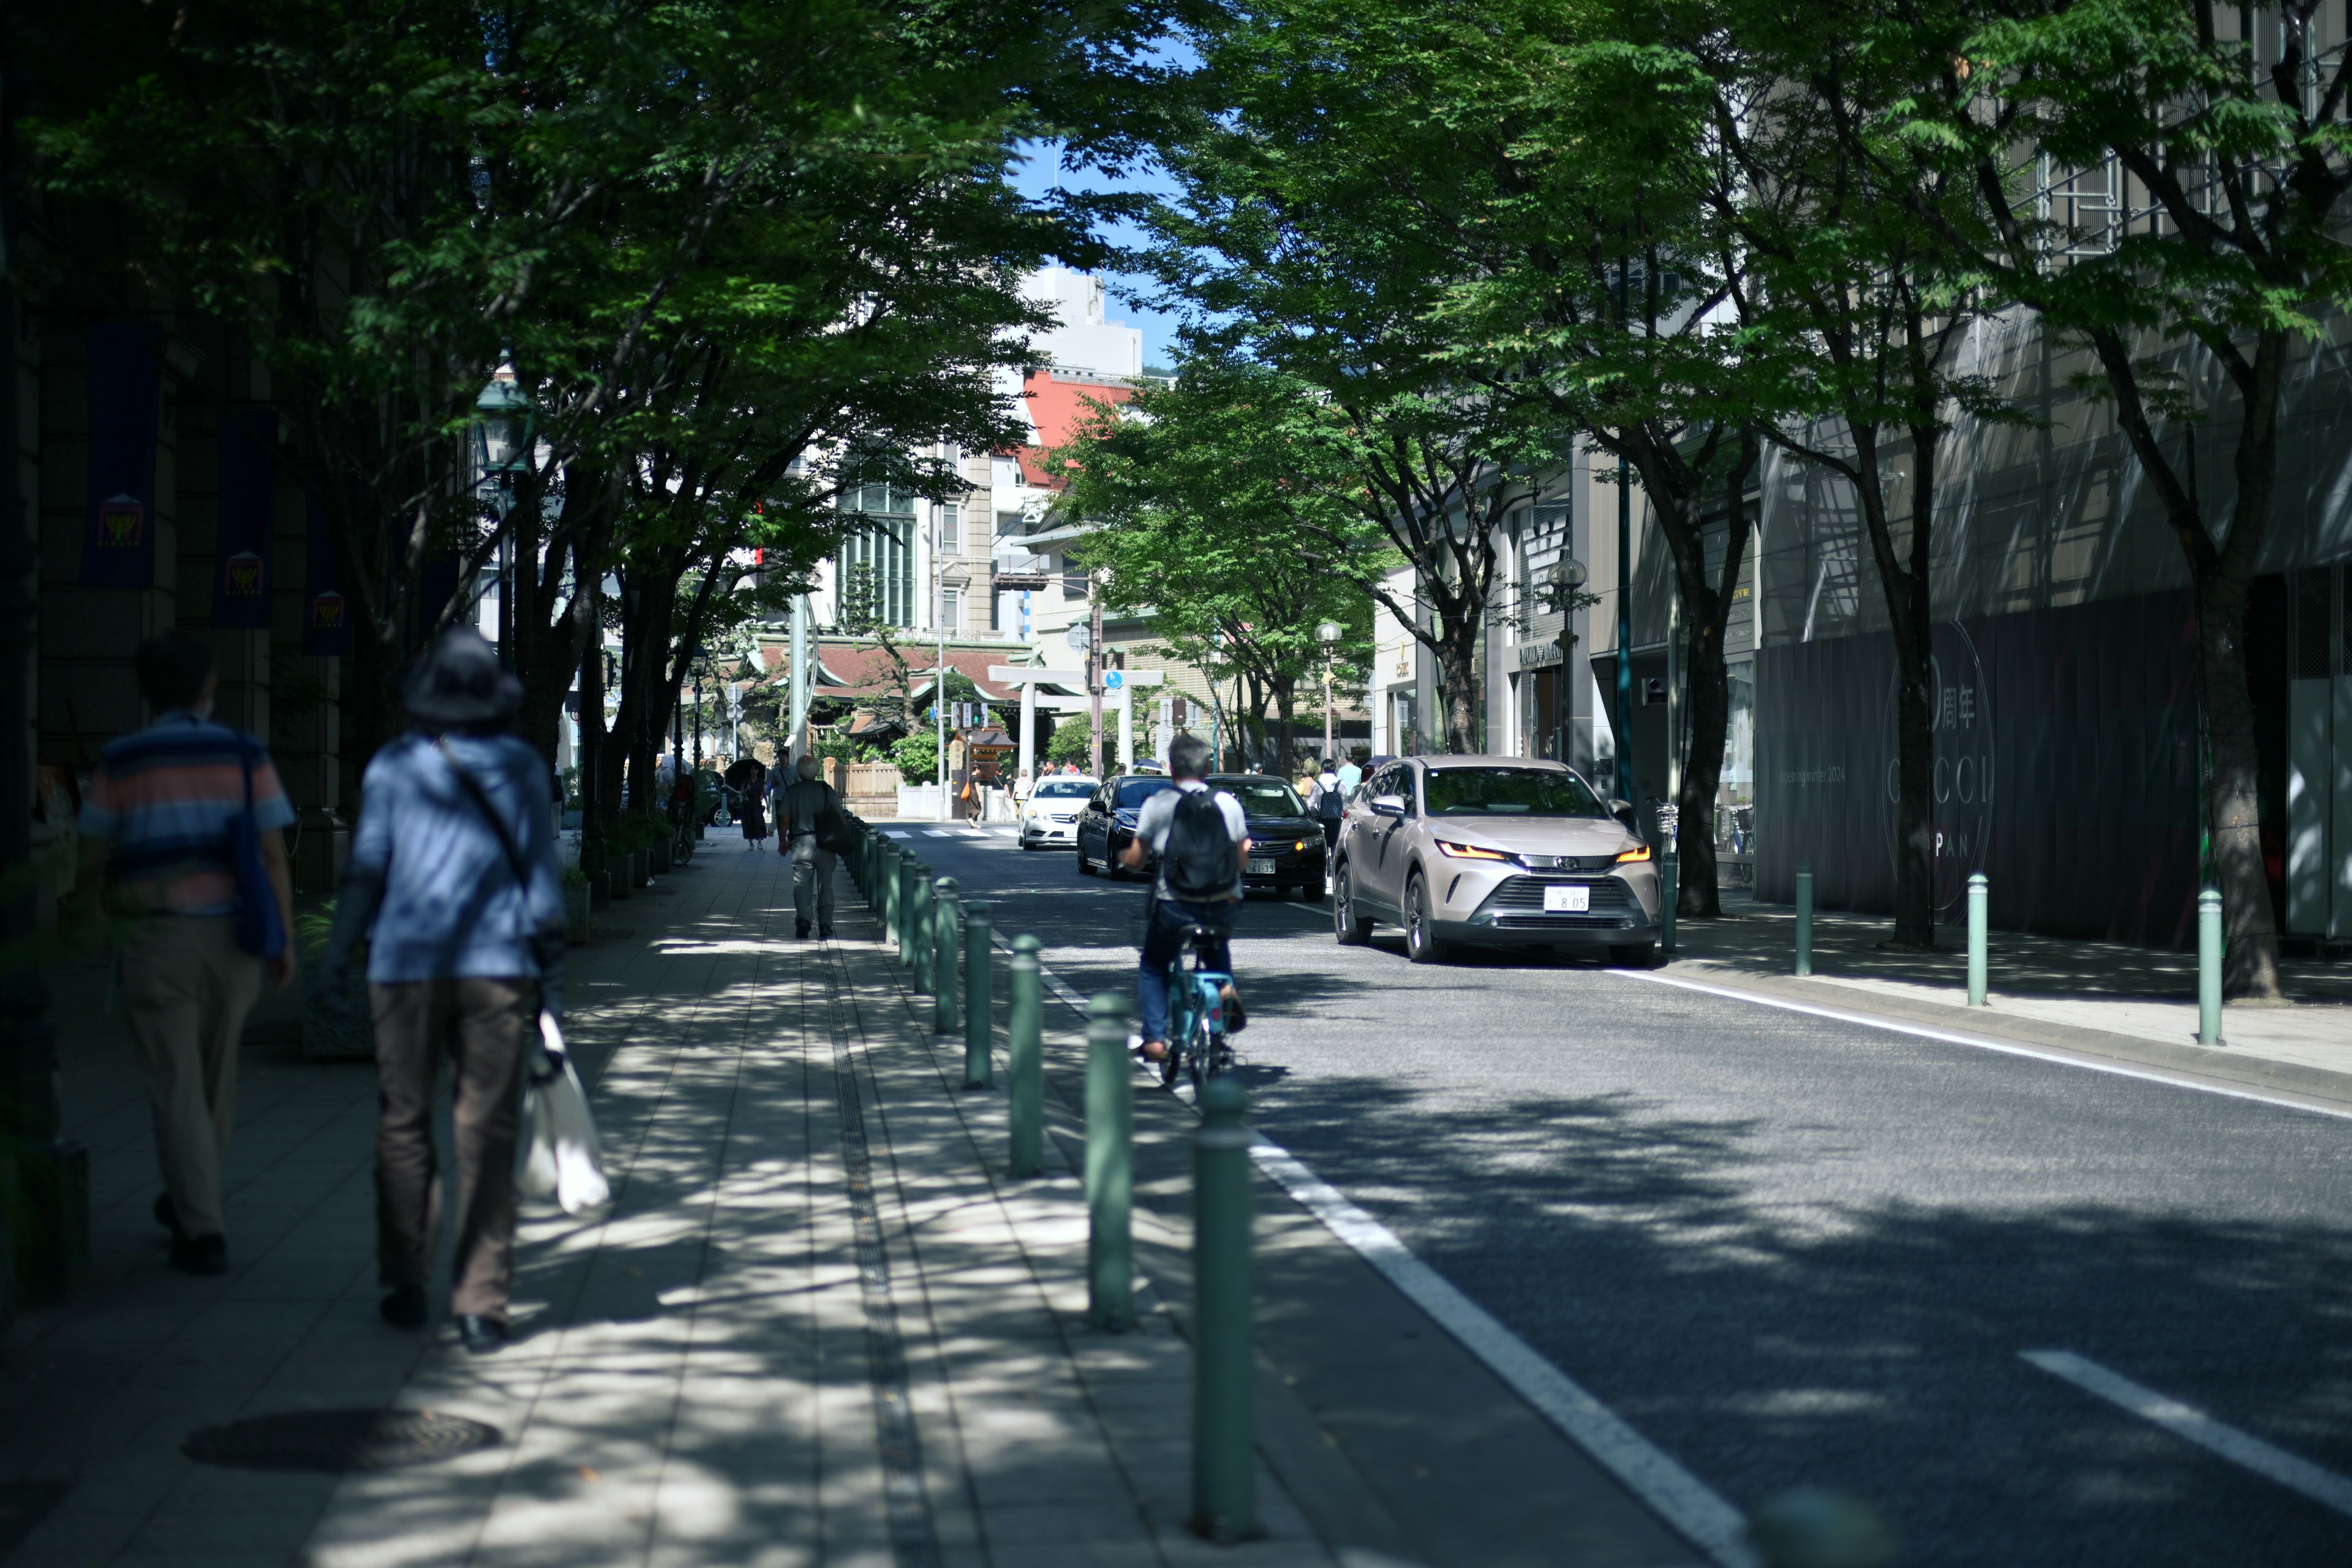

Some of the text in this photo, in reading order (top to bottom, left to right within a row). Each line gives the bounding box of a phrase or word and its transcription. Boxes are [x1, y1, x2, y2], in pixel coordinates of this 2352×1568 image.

[1780, 766, 1845, 787] opening winter 2024
[1887, 755, 1987, 804] GCCI
[1926, 832, 1968, 858] PAN
